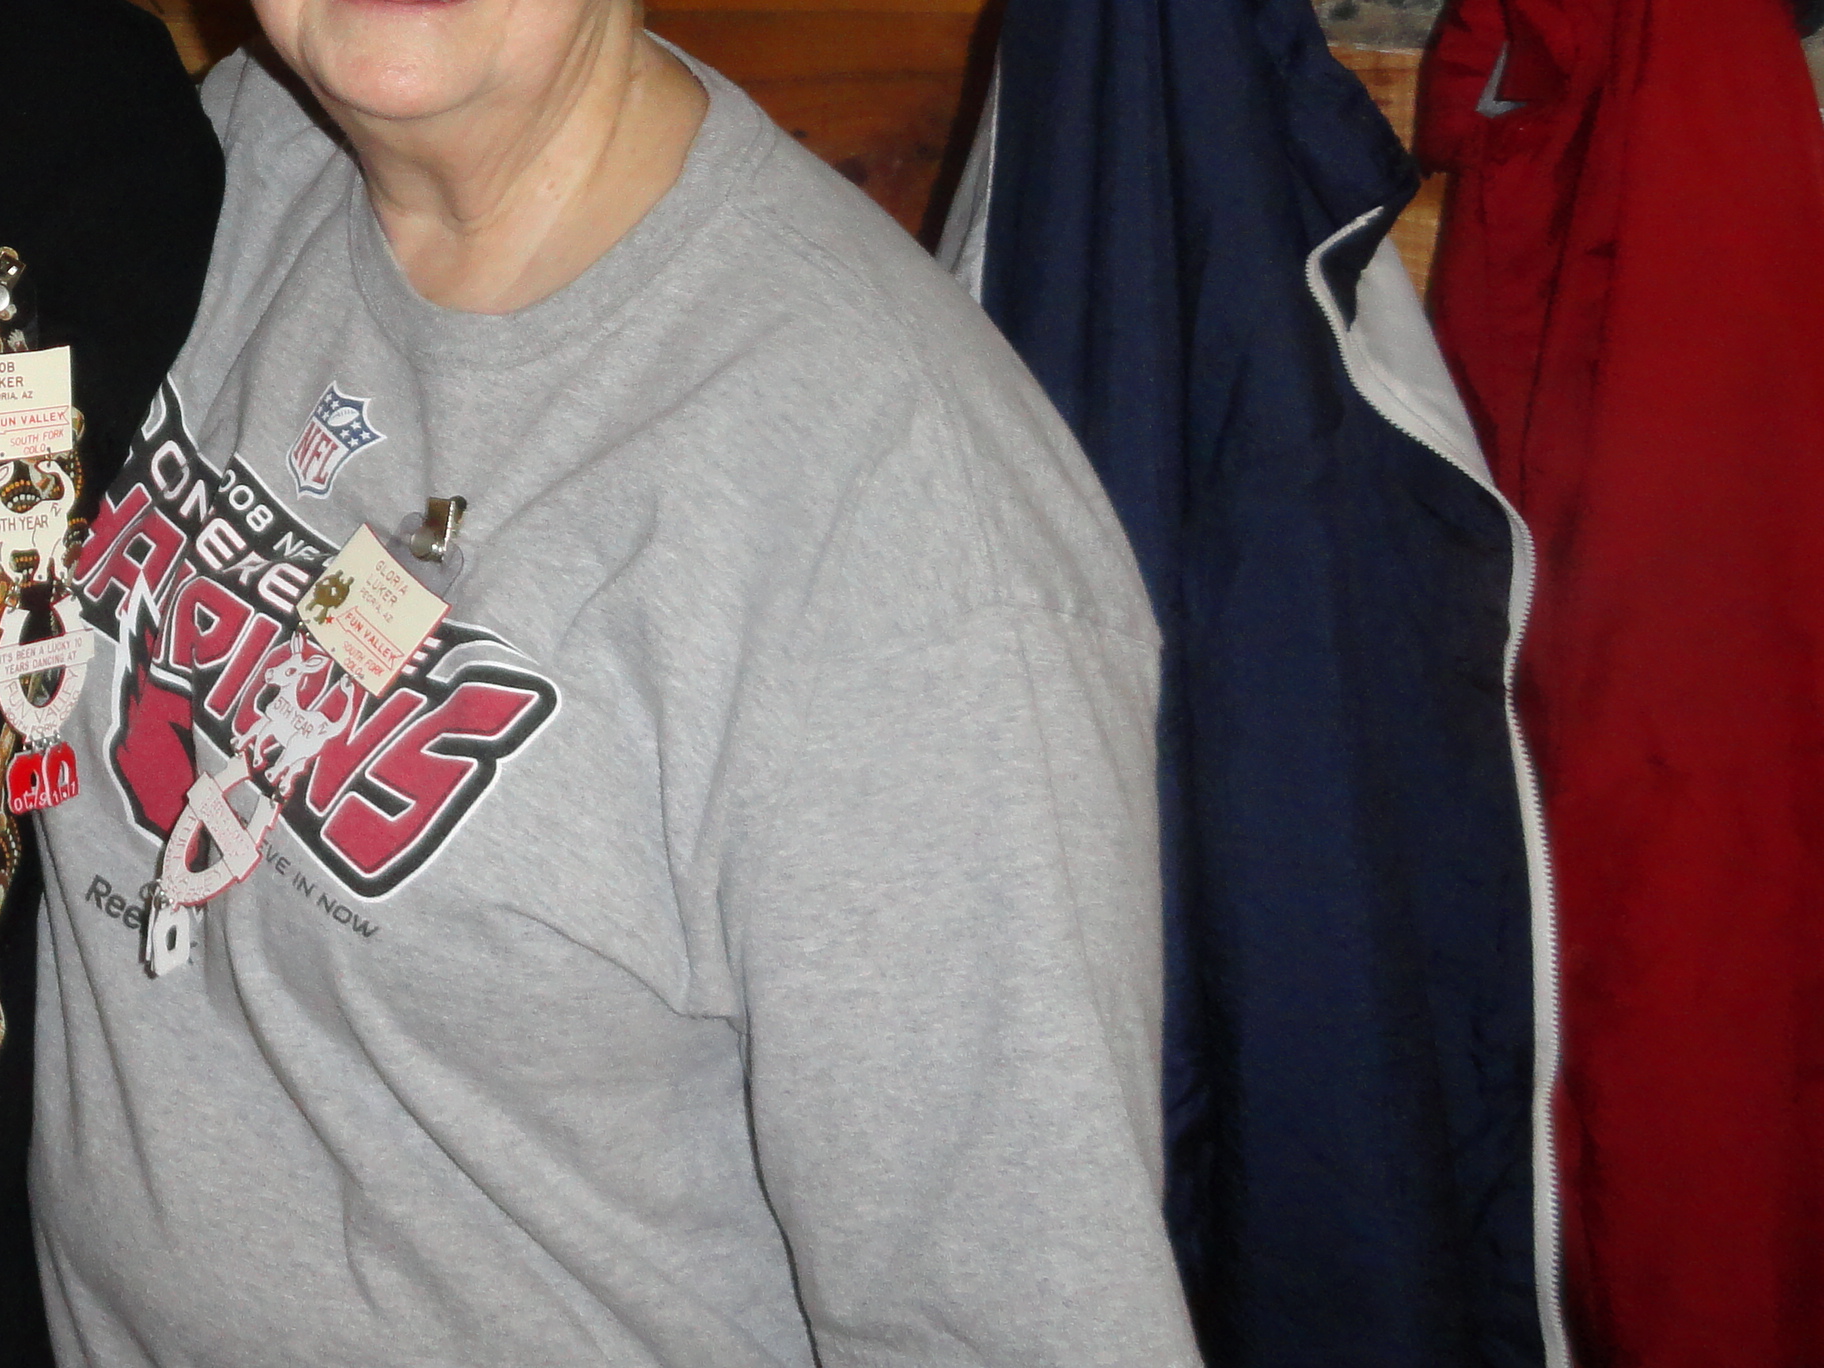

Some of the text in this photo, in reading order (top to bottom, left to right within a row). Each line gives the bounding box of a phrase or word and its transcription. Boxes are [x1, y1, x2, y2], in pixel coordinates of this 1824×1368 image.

[22, 391, 33, 399] AZ
[21, 412, 64, 423] VALLEY
[10, 430, 64, 447] SOUTH FORK
[293, 436, 339, 486] NFL
[20, 514, 49, 531] YEAR
[365, 575, 398, 606] LUKER
[375, 560, 408, 596] GLORIA
[0, 652, 12, 665] IT'S
[16, 649, 35, 660] BEEN
[39, 647, 44, 655] A
[48, 640, 71, 653] LUCKY
[345, 613, 397, 661] FUN VALLEY
[5, 651, 77, 675] YEARS DANCING AT
[342, 641, 385, 677] SOUTH FORK
[5, 669, 79, 723] FUN VALLEY
[276, 697, 315, 737] 5TH YEAR
[292, 871, 379, 938] IN NOW
